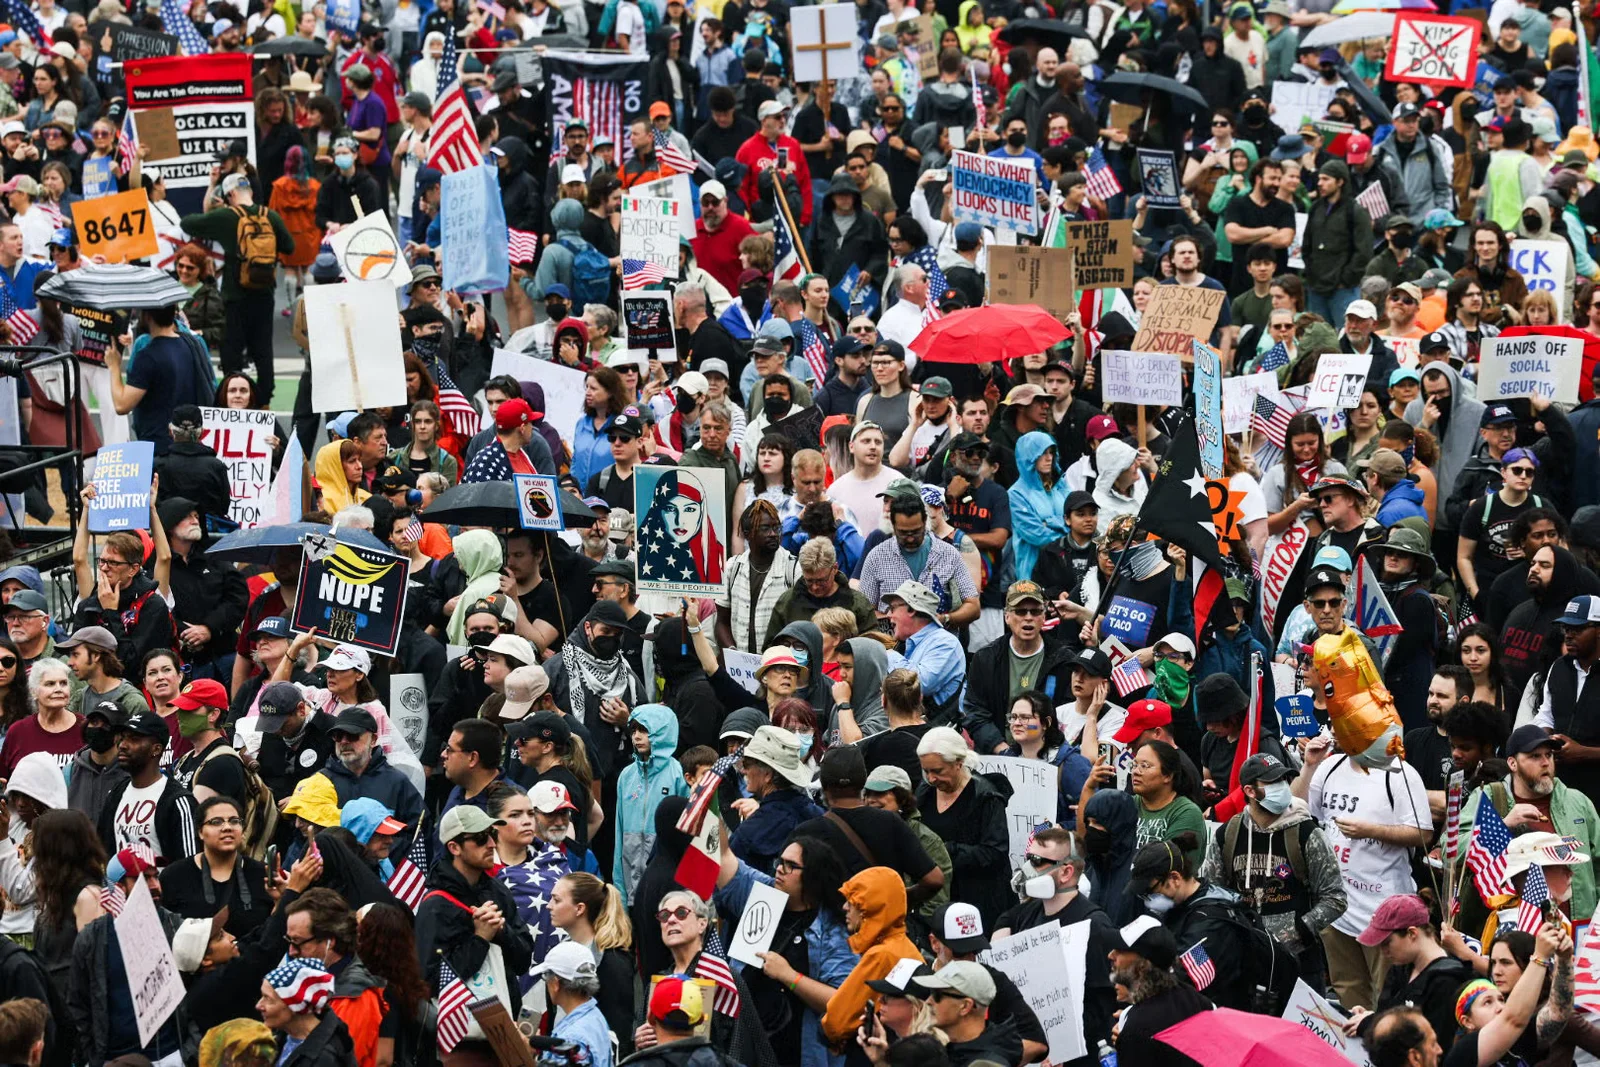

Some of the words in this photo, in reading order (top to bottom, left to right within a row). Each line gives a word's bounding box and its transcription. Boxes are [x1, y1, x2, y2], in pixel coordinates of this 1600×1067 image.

[1424, 26, 1453, 40] KIM
[117, 31, 171, 55] OPPRESSION
[1409, 41, 1459, 60] JONG
[1410, 58, 1455, 77] DON
[134, 90, 150, 100] You
[153, 87, 169, 98] Are
[171, 86, 186, 97] The
[188, 84, 243, 96] Government
[956, 152, 982, 173] THIS
[985, 159, 995, 177] IS
[997, 162, 1031, 184] WHAT
[956, 170, 1031, 203] DEMOCRACY
[450, 192, 474, 210] OFF
[640, 200, 662, 216] MY
[956, 189, 998, 214] LOOKS
[1001, 198, 1032, 222] LIKE
[84, 208, 146, 244] 8647
[445, 208, 480, 230] EVERY
[622, 218, 678, 238] EXISTENCE
[446, 227, 480, 248] THING
[1069, 222, 1109, 240] THIS
[644, 238, 655, 252] IS
[1086, 240, 1118, 254] SIGN
[1153, 286, 1178, 300] THIS
[1180, 288, 1194, 302] IS
[1196, 290, 1225, 308] NOT
[1154, 302, 1212, 320] NORMAL
[1146, 316, 1172, 329] THIS
[1176, 318, 1193, 332] IS
[1496, 341, 1537, 356] HANDS
[1545, 342, 1568, 355] OFF
[1106, 355, 1130, 370] LET
[1132, 358, 1144, 370] US
[1148, 359, 1178, 372] DRIVE
[1510, 360, 1551, 373] SOCIAL
[1109, 370, 1130, 382] THE
[1136, 372, 1178, 388] MIGHTY
[1314, 374, 1339, 393] ICE
[1500, 380, 1555, 396] SECURITY
[1108, 384, 1132, 396] FROM
[1132, 384, 1148, 398] OUR
[1150, 389, 1178, 400] MIDST
[1346, 385, 1356, 396] NO
[204, 409, 274, 426] EPUBLICONS
[97, 449, 124, 466] FREE
[93, 463, 140, 479] SPEECH
[94, 479, 121, 494] FREE
[91, 492, 149, 510] COUNTRY
[108, 518, 128, 528] ACLU
[331, 607, 358, 624] SINCE
[1108, 604, 1130, 618] LET'S
[1130, 609, 1147, 622] GO
[328, 620, 356, 642] 1776
[1110, 617, 1132, 632] TACO
[1502, 626, 1544, 653] POLO
[730, 667, 742, 677] DO
[1288, 697, 1300, 706] WE
[1290, 707, 1303, 716] the
[1286, 716, 1312, 726] PEOPLE
[1016, 764, 1046, 788] THE
[116, 800, 157, 824] NO
[1320, 792, 1360, 814] LESS
[1013, 814, 1040, 832] THE
[1010, 938, 1029, 958] should
[1031, 935, 1040, 948] be
[1040, 930, 1061, 945] feeding
[1032, 996, 1046, 1010] the
[1046, 988, 1061, 1007] rich
[1044, 1008, 1067, 1032] parade!
